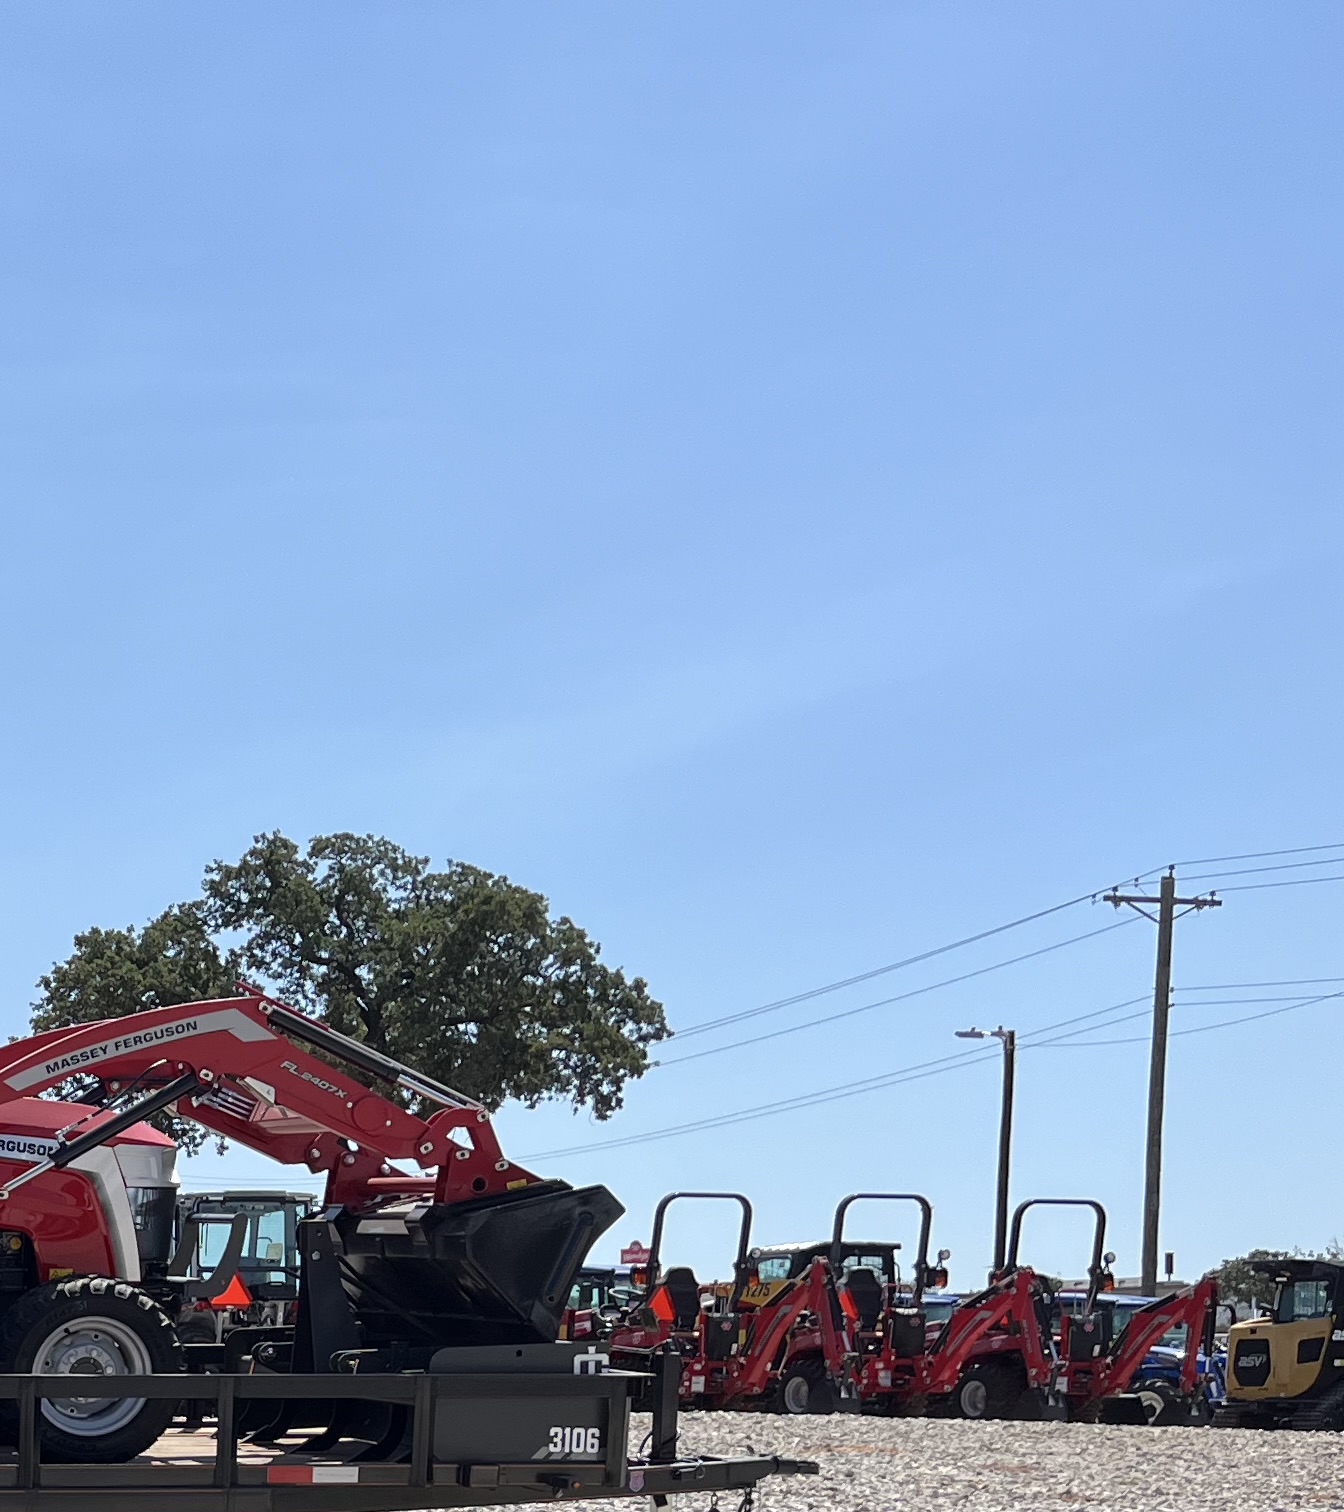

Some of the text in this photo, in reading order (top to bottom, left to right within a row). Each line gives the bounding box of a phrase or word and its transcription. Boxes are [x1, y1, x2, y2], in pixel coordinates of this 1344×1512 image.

[45, 1020, 198, 1075] MASSEY FERGUSON
[279, 1060, 348, 1099] FL.2407X
[549, 1427, 600, 1454] 3106
